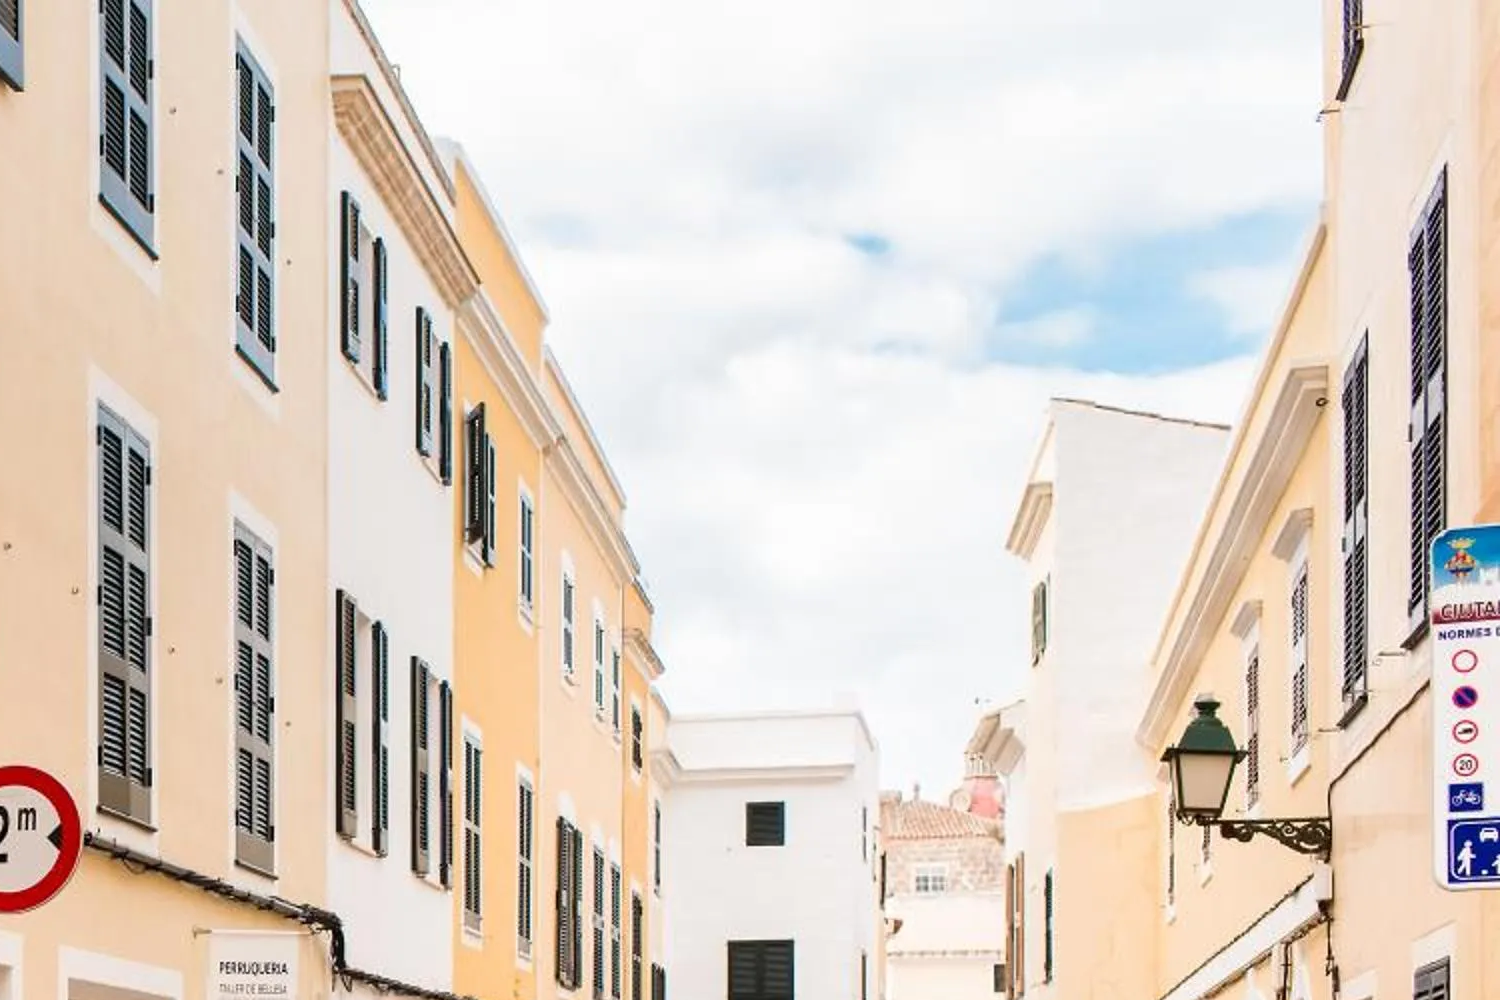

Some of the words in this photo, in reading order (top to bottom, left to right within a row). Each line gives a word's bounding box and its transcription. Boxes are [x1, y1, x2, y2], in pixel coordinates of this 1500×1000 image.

[1437, 627, 1491, 641] NORMES
[1459, 759, 1473, 771] 20
[219, 961, 288, 976] PERRUQUERIA
